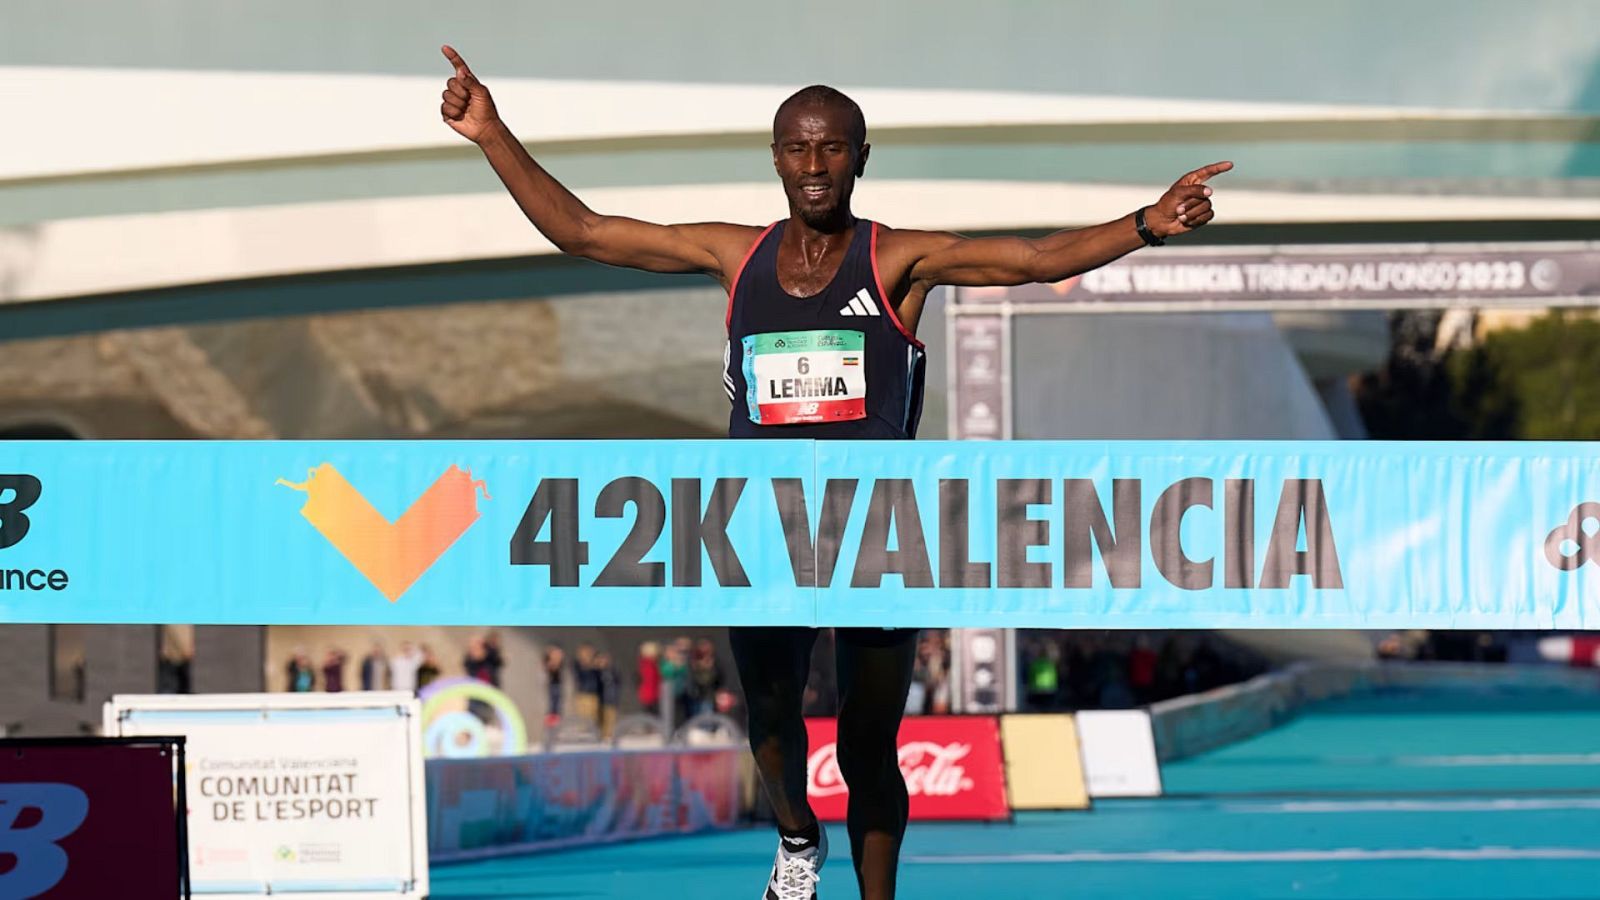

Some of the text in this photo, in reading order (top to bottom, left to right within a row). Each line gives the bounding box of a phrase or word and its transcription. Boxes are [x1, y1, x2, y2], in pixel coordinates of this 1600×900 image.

[1132, 263, 1246, 293] VALENCIA
[1244, 262, 1349, 292] TRINIDAD
[1350, 261, 1455, 292] ALFONSO
[1456, 260, 1526, 291] 2023
[797, 356, 810, 375] 6
[770, 376, 848, 399] LEMMA
[510, 476, 1344, 590] 42K VALENCIA
[200, 757, 358, 770] Comunitat Valenciana
[200, 774, 357, 797] COMUNITAT
[213, 798, 379, 821] DE L'ESPORT
